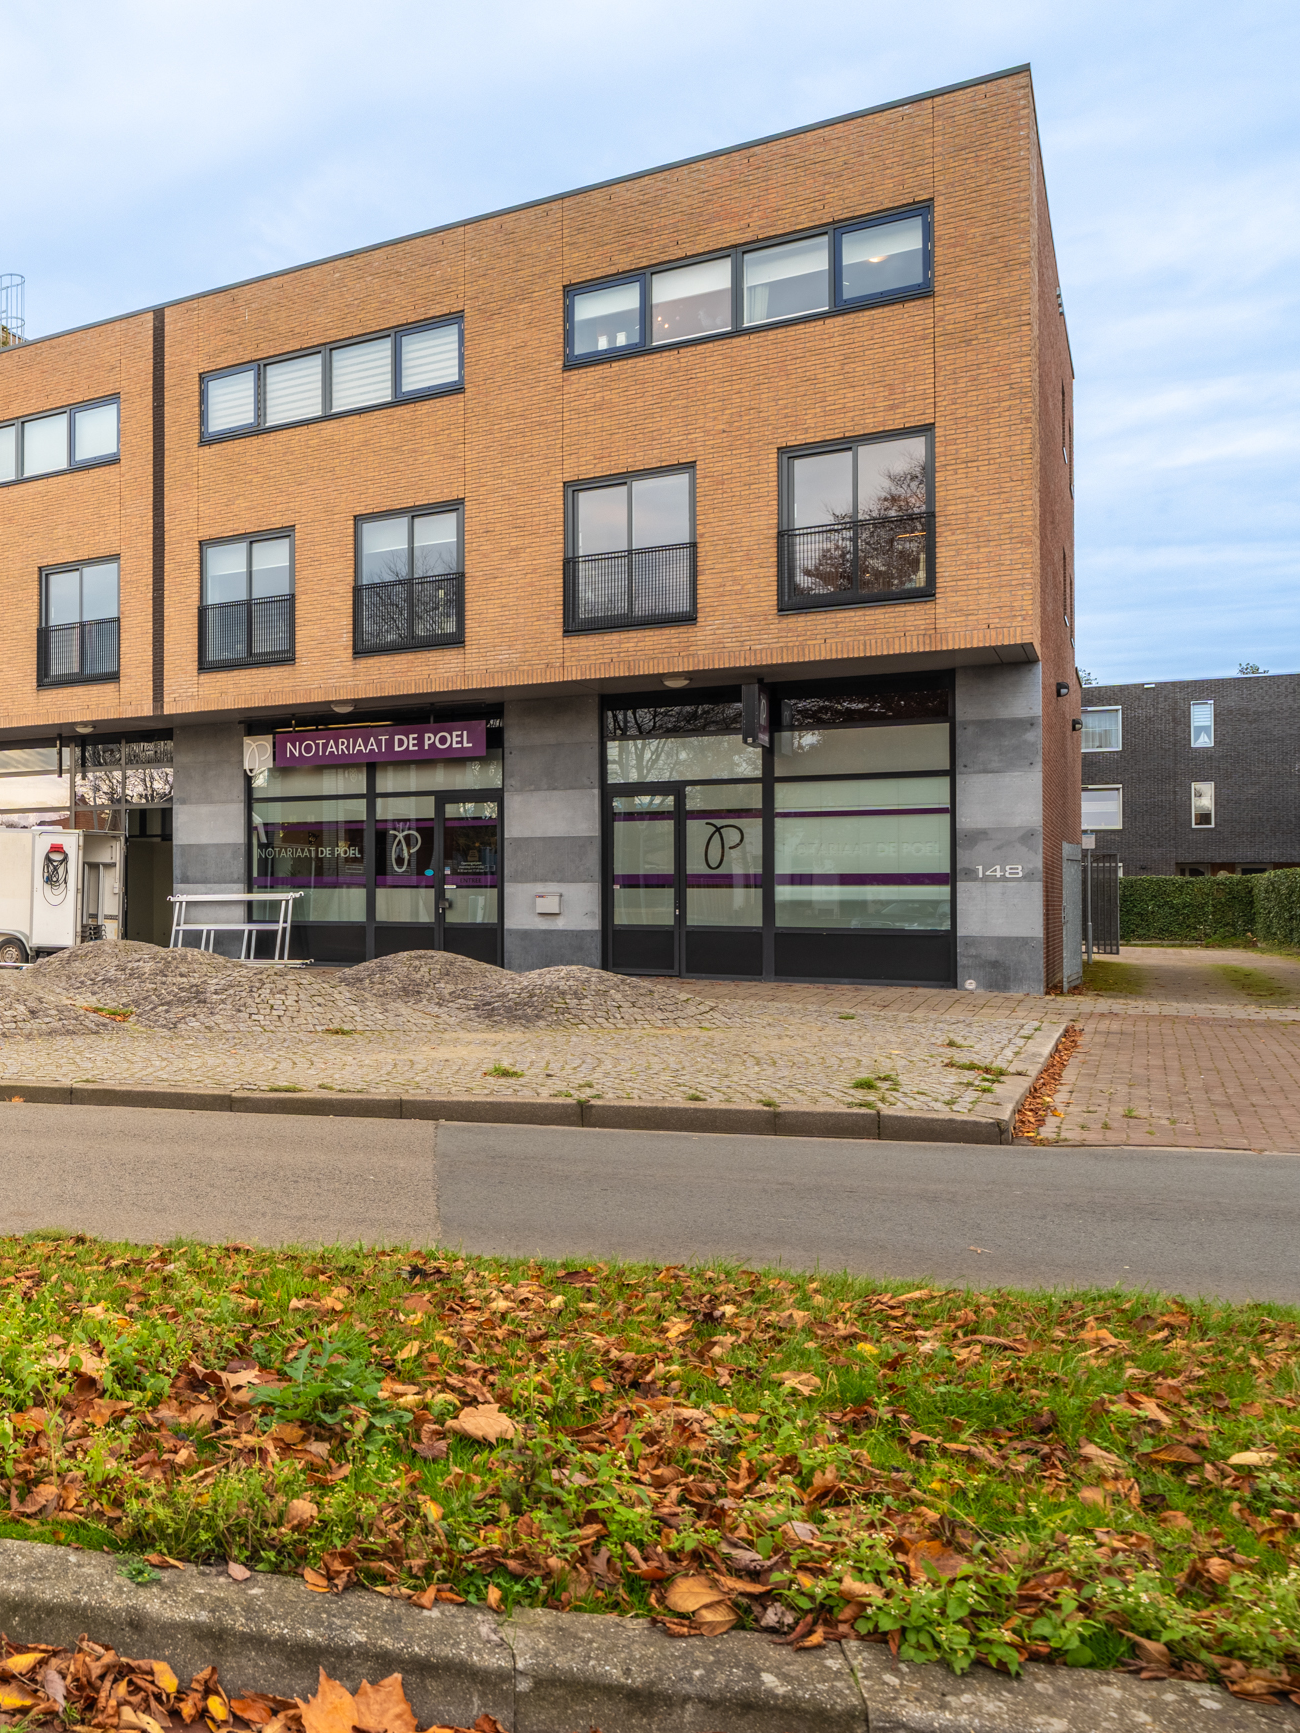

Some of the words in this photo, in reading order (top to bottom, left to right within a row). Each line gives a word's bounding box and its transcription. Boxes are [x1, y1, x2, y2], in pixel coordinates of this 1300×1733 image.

[286, 735, 389, 758] NOTARIAAT
[394, 734, 418, 752] DE
[424, 730, 473, 750] POEL
[257, 848, 316, 859] NOTARIAAT
[318, 848, 332, 858] DE
[334, 847, 362, 858] POEL
[975, 865, 1023, 878] 148
